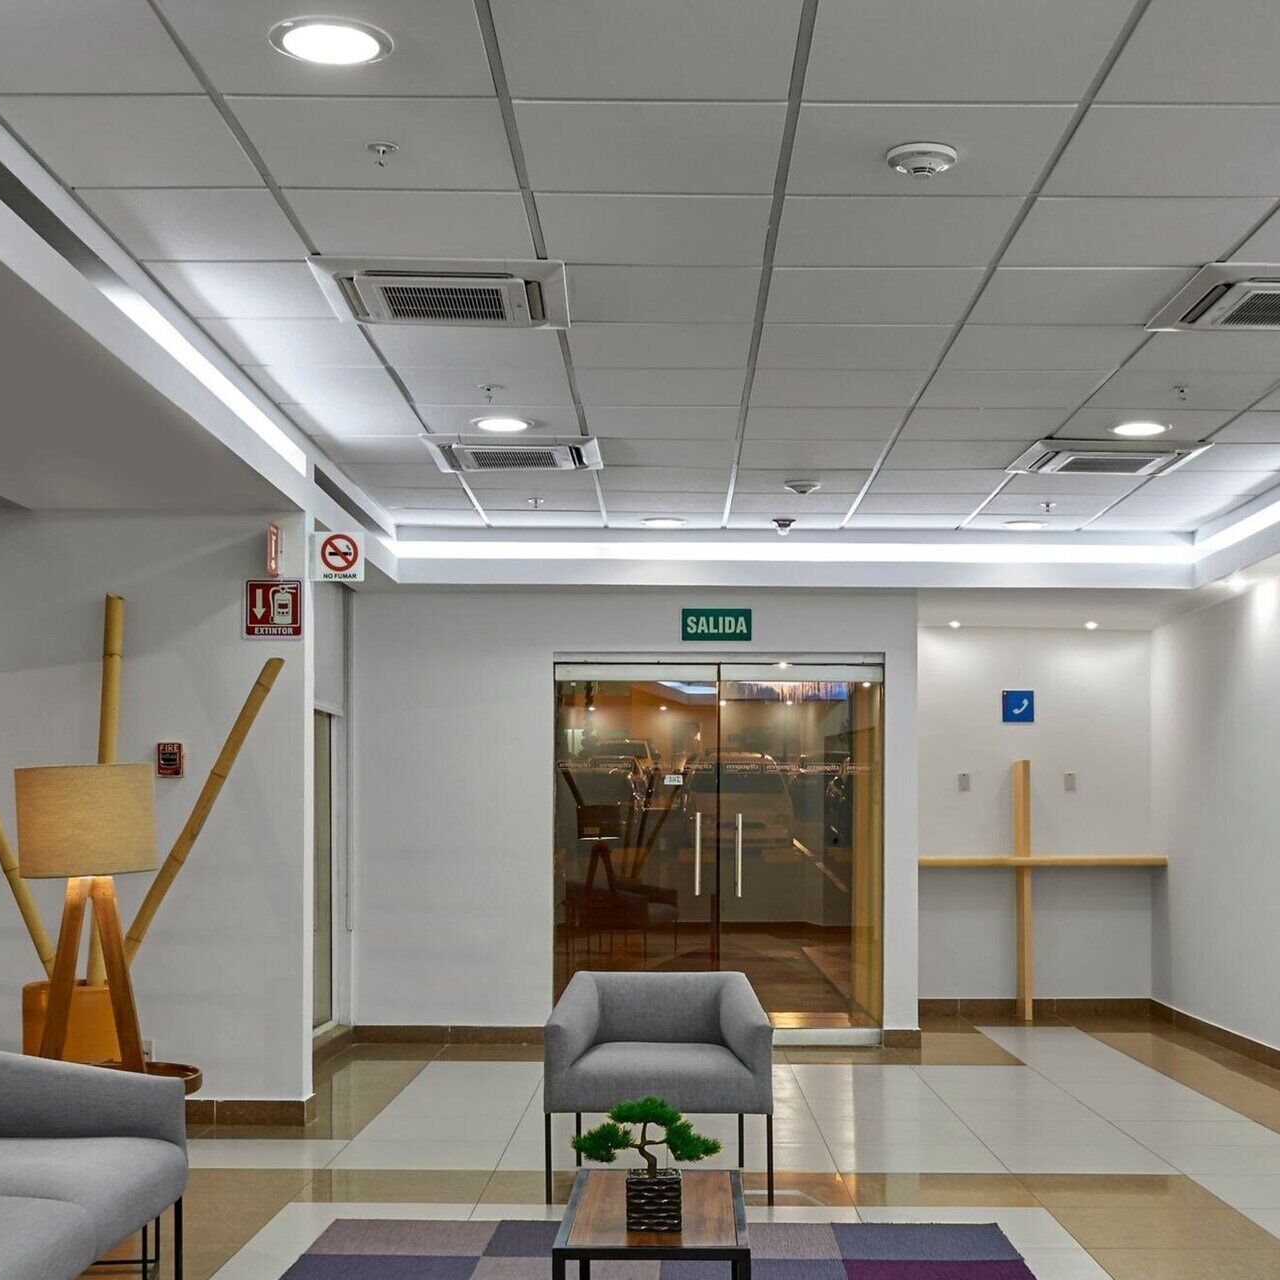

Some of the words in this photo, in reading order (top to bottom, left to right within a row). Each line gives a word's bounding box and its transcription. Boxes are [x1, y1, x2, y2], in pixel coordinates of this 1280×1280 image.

[686, 616, 748, 634] SALIDA
[254, 627, 294, 635] EXTINTOR
[160, 744, 179, 752] FIRE
